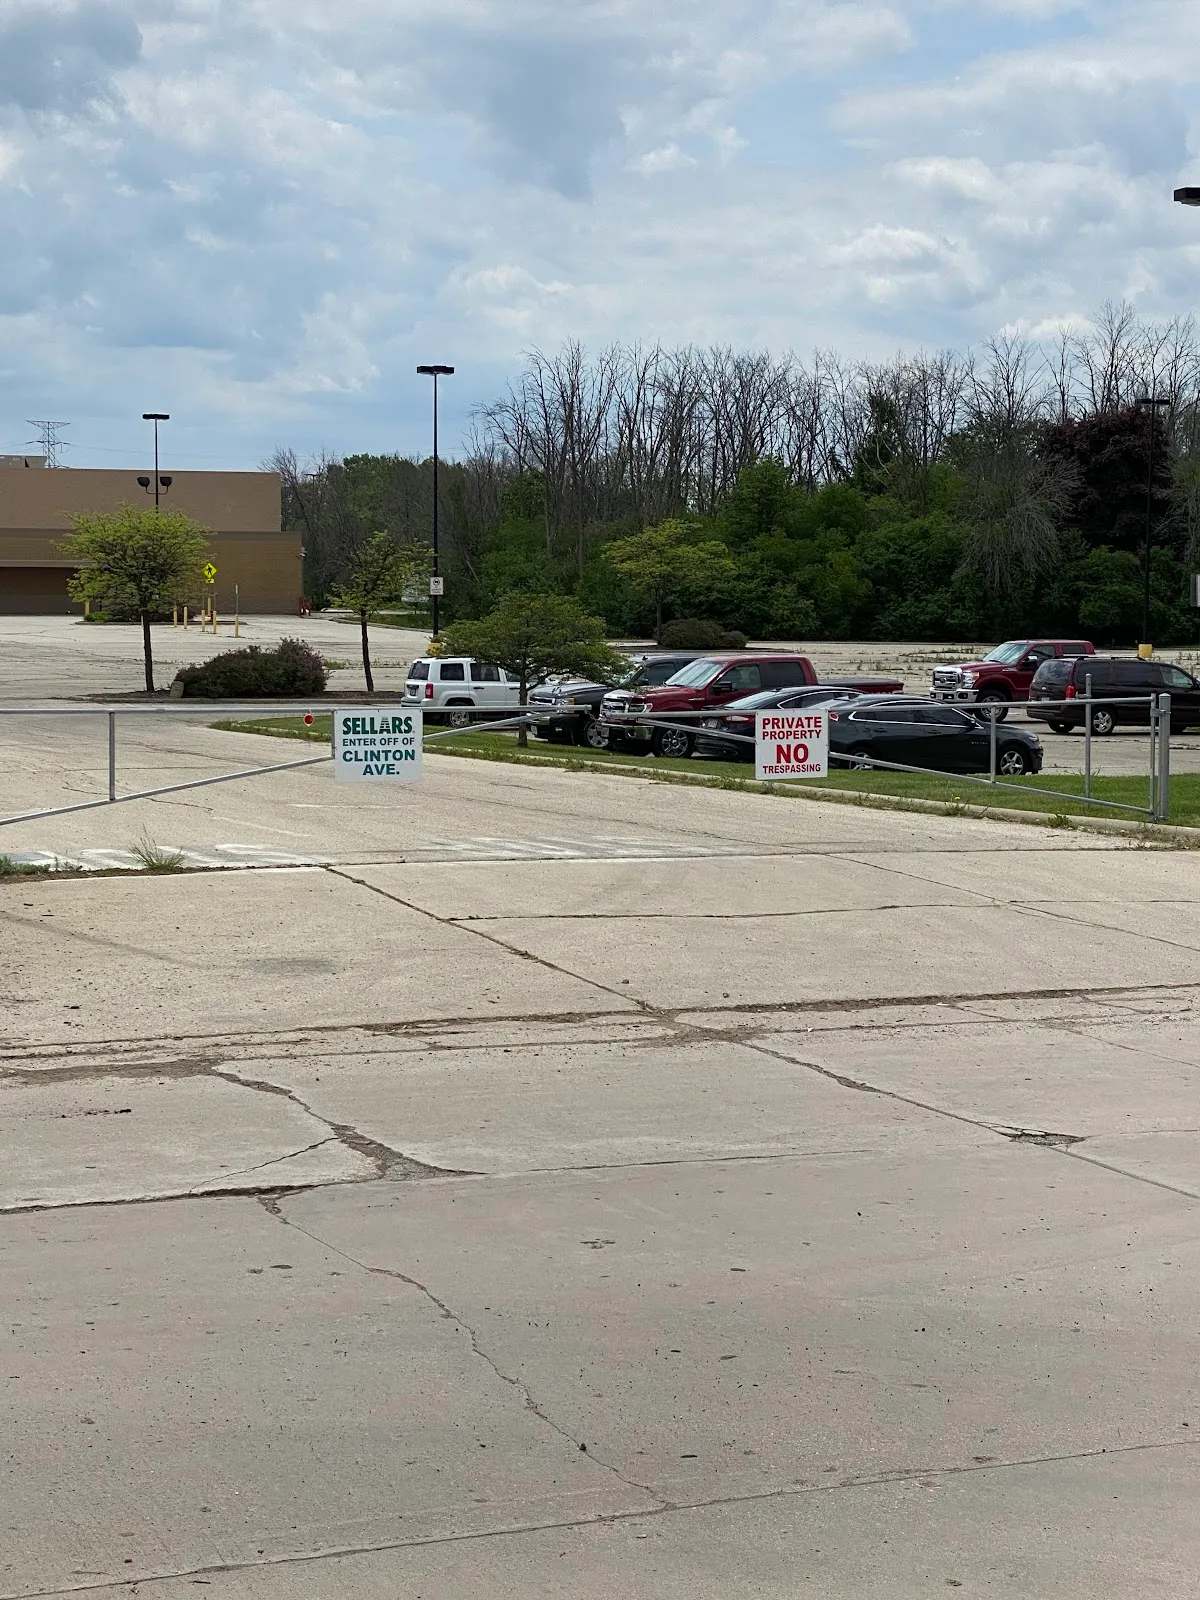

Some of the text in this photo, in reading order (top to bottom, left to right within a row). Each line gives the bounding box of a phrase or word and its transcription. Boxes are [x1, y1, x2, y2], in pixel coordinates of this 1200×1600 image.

[342, 716, 413, 735] SELLARS
[762, 716, 822, 730] PRIVATE
[762, 729, 822, 740] PROPERTY
[342, 737, 415, 747] ENTER OFF OF
[342, 749, 416, 762] CLINTON
[776, 743, 809, 764] NO
[362, 763, 400, 776] AVE.
[762, 764, 821, 774] TRESPASSING
